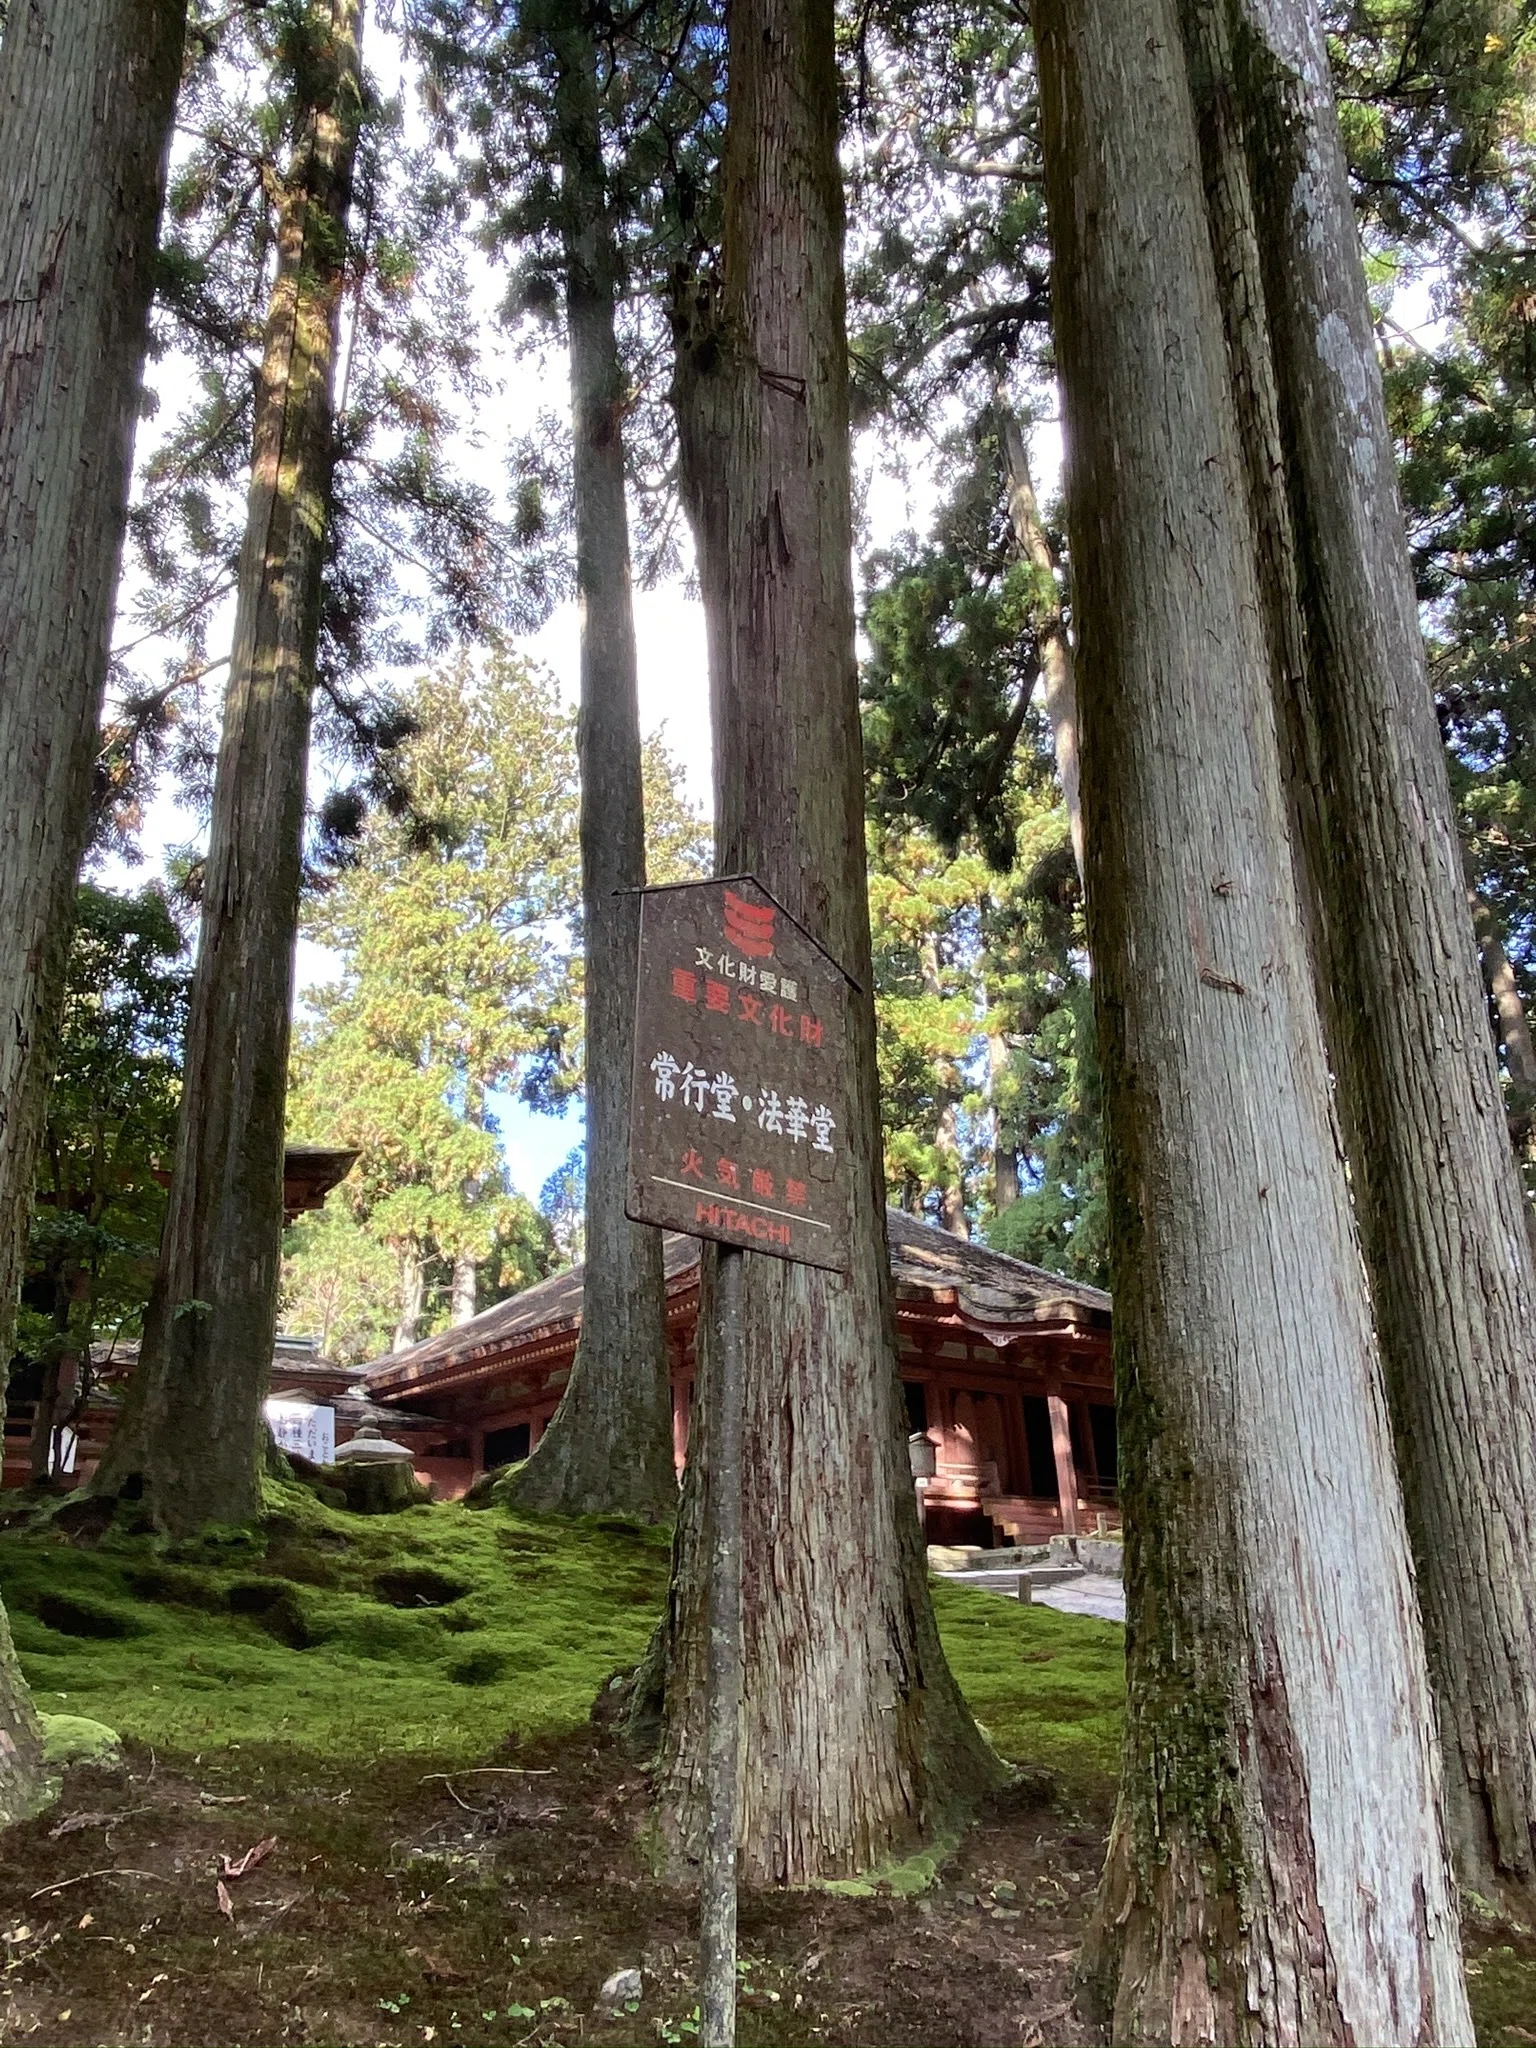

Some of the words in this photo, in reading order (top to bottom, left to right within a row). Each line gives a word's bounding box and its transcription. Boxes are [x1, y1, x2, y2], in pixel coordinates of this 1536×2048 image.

[695, 946, 798, 1002] 文化財愛護
[672, 968, 823, 1048] 重要文化財
[695, 1202, 791, 1245] HITACHI
